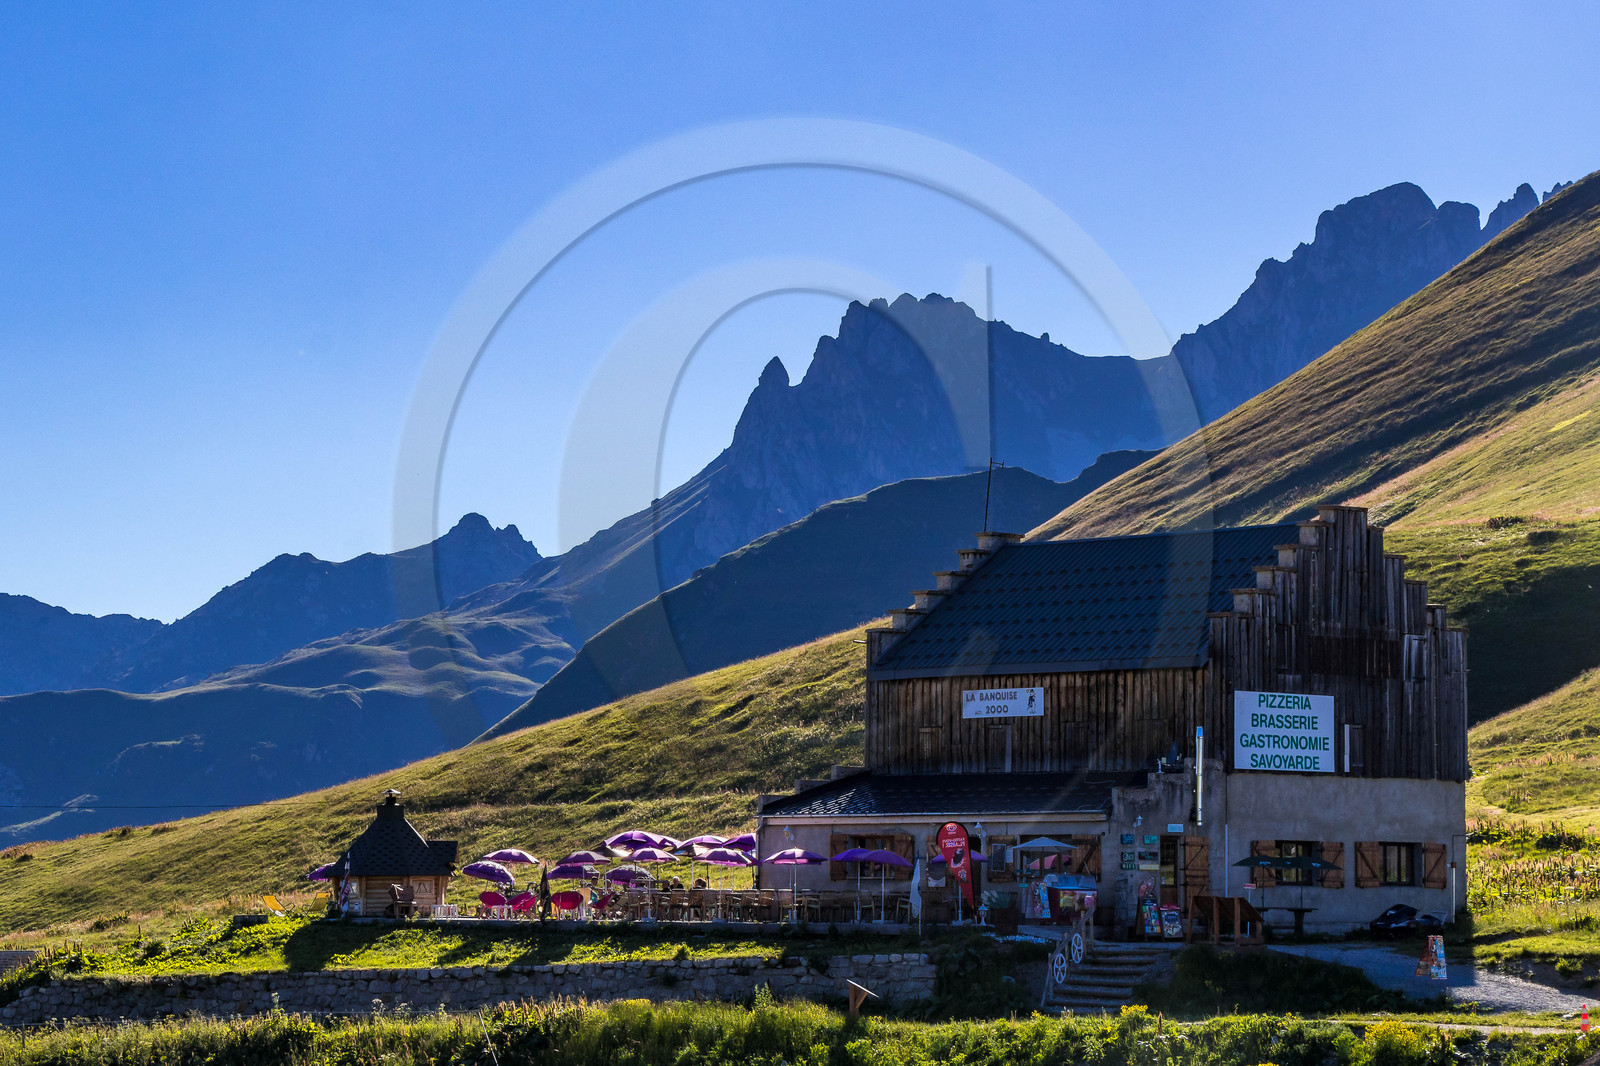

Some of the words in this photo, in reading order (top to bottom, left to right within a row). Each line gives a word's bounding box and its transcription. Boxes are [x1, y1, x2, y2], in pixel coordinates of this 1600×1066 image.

[965, 693, 976, 702] LA
[979, 691, 1018, 702] BANQUISE
[1258, 693, 1312, 710] PIZZERIA
[985, 704, 1009, 715] 2000
[1251, 713, 1319, 730] BRASSERIE
[1240, 733, 1330, 751] GASTRONOMIE
[1250, 753, 1320, 770] SAVOYARDE
